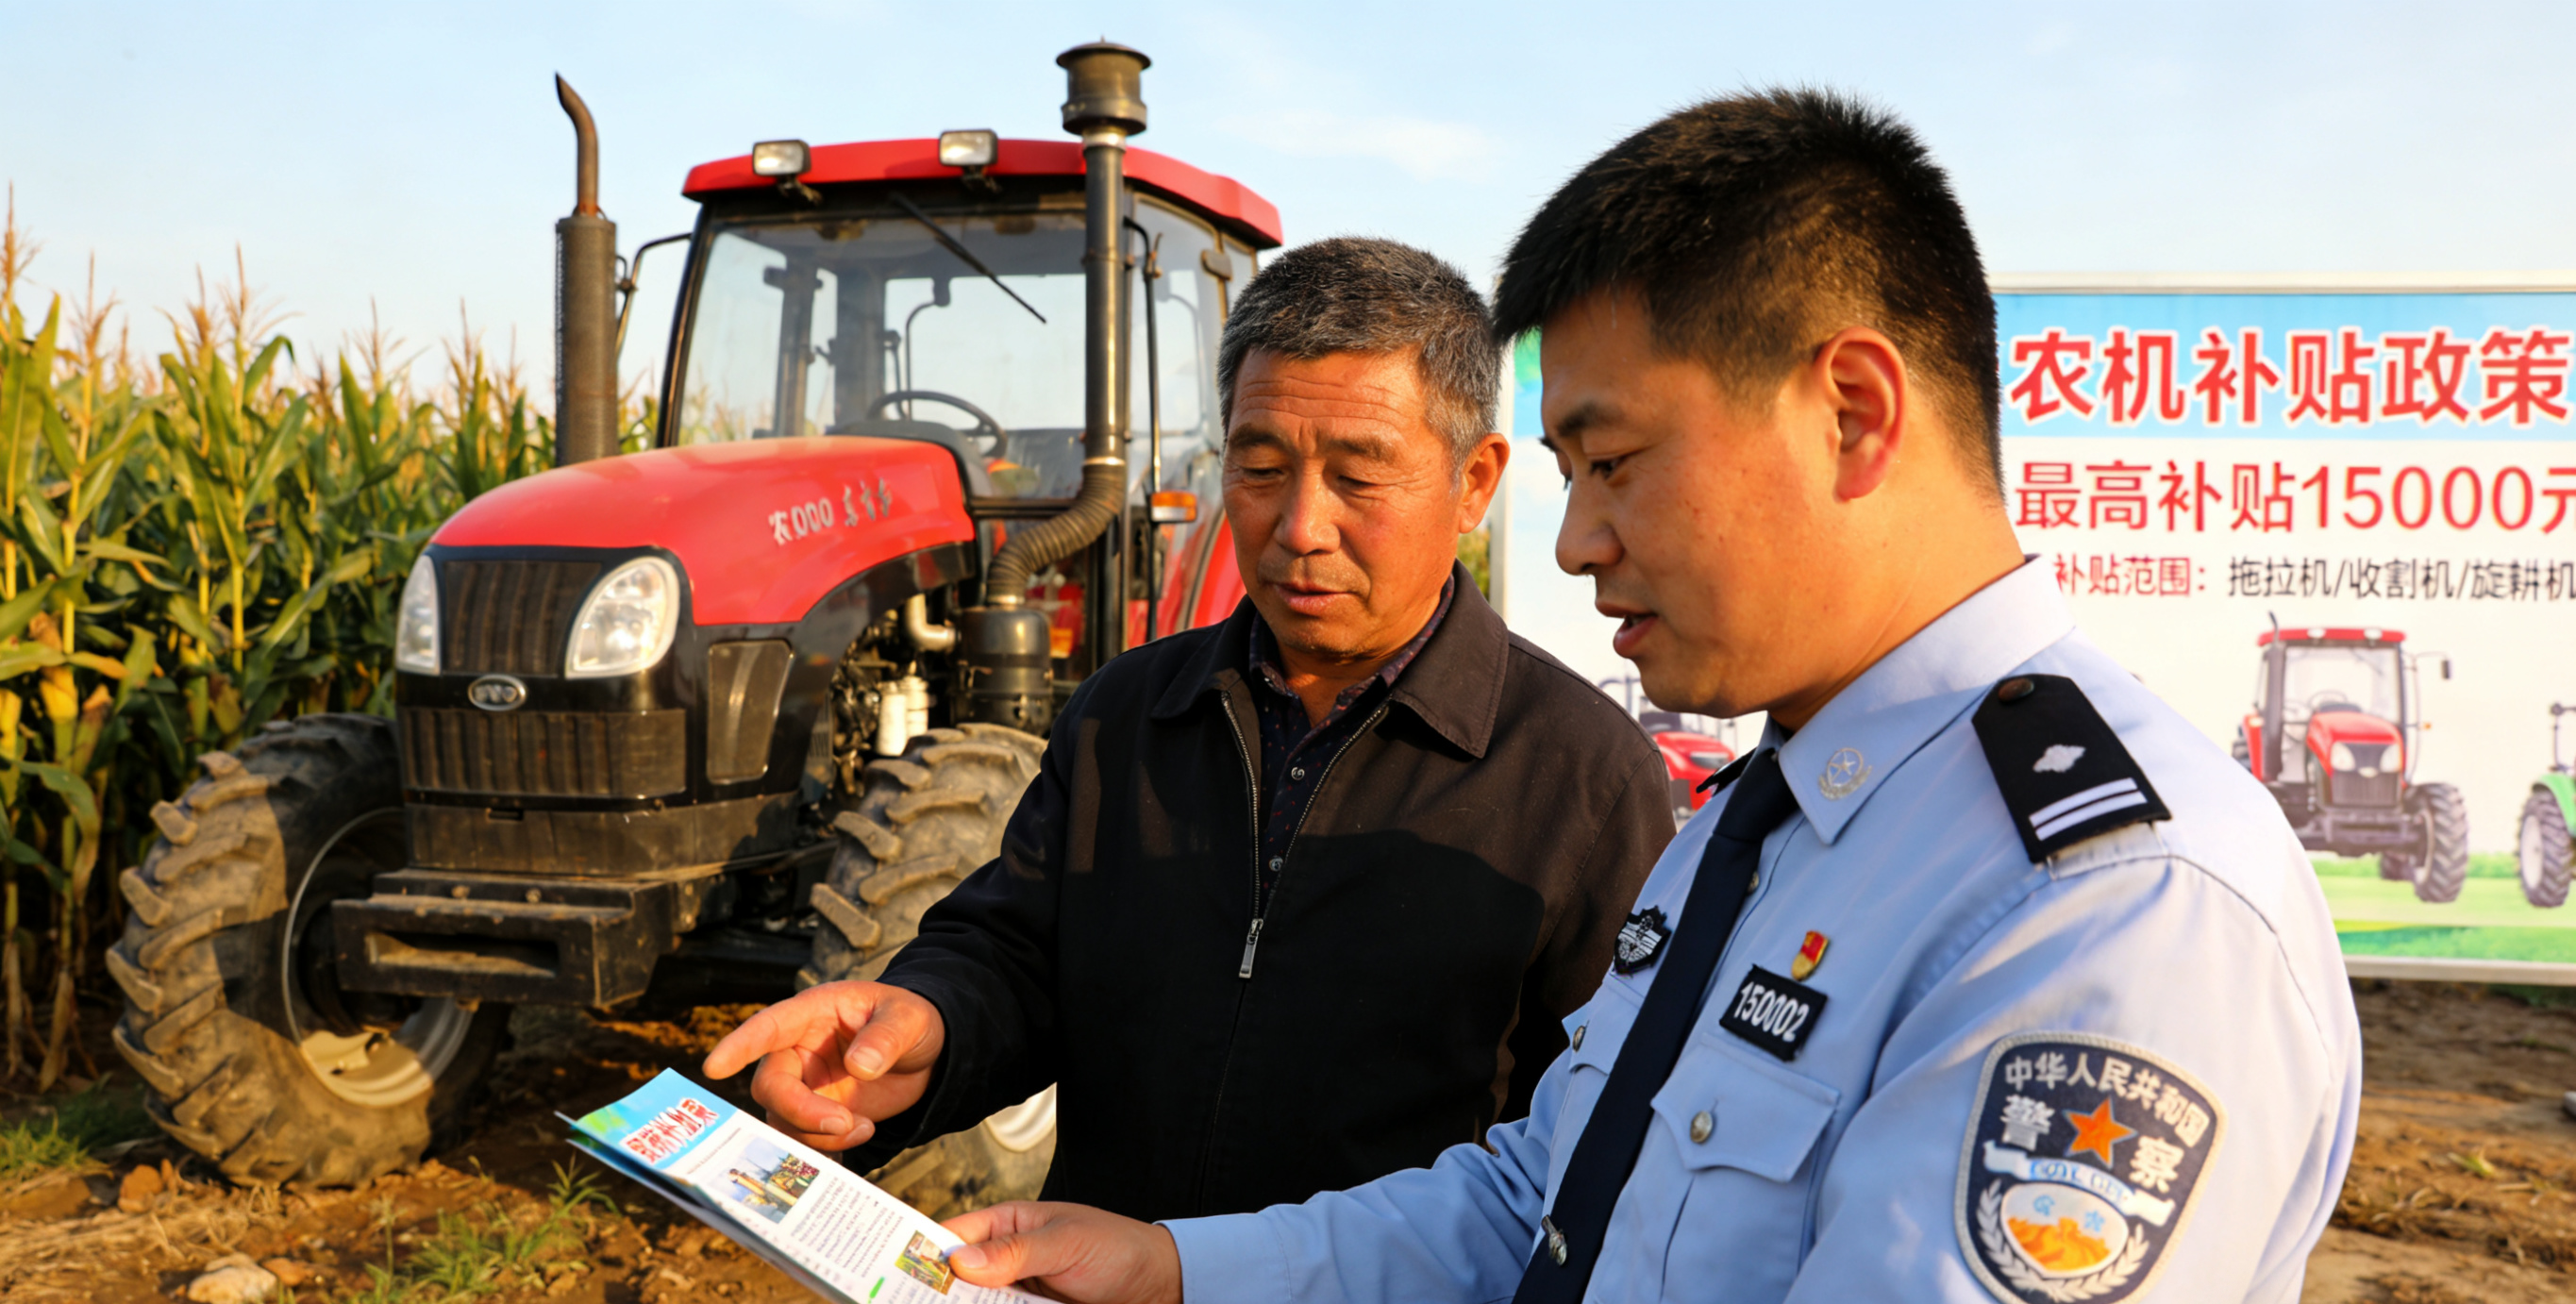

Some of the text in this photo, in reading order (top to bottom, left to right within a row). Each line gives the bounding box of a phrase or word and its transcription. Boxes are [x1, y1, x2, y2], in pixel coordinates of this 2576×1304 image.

[2010, 329, 2571, 426] 农机补贴政策
[1734, 981, 1810, 1043] 150002
[2004, 1052, 2210, 1147] 中华人民共和国
